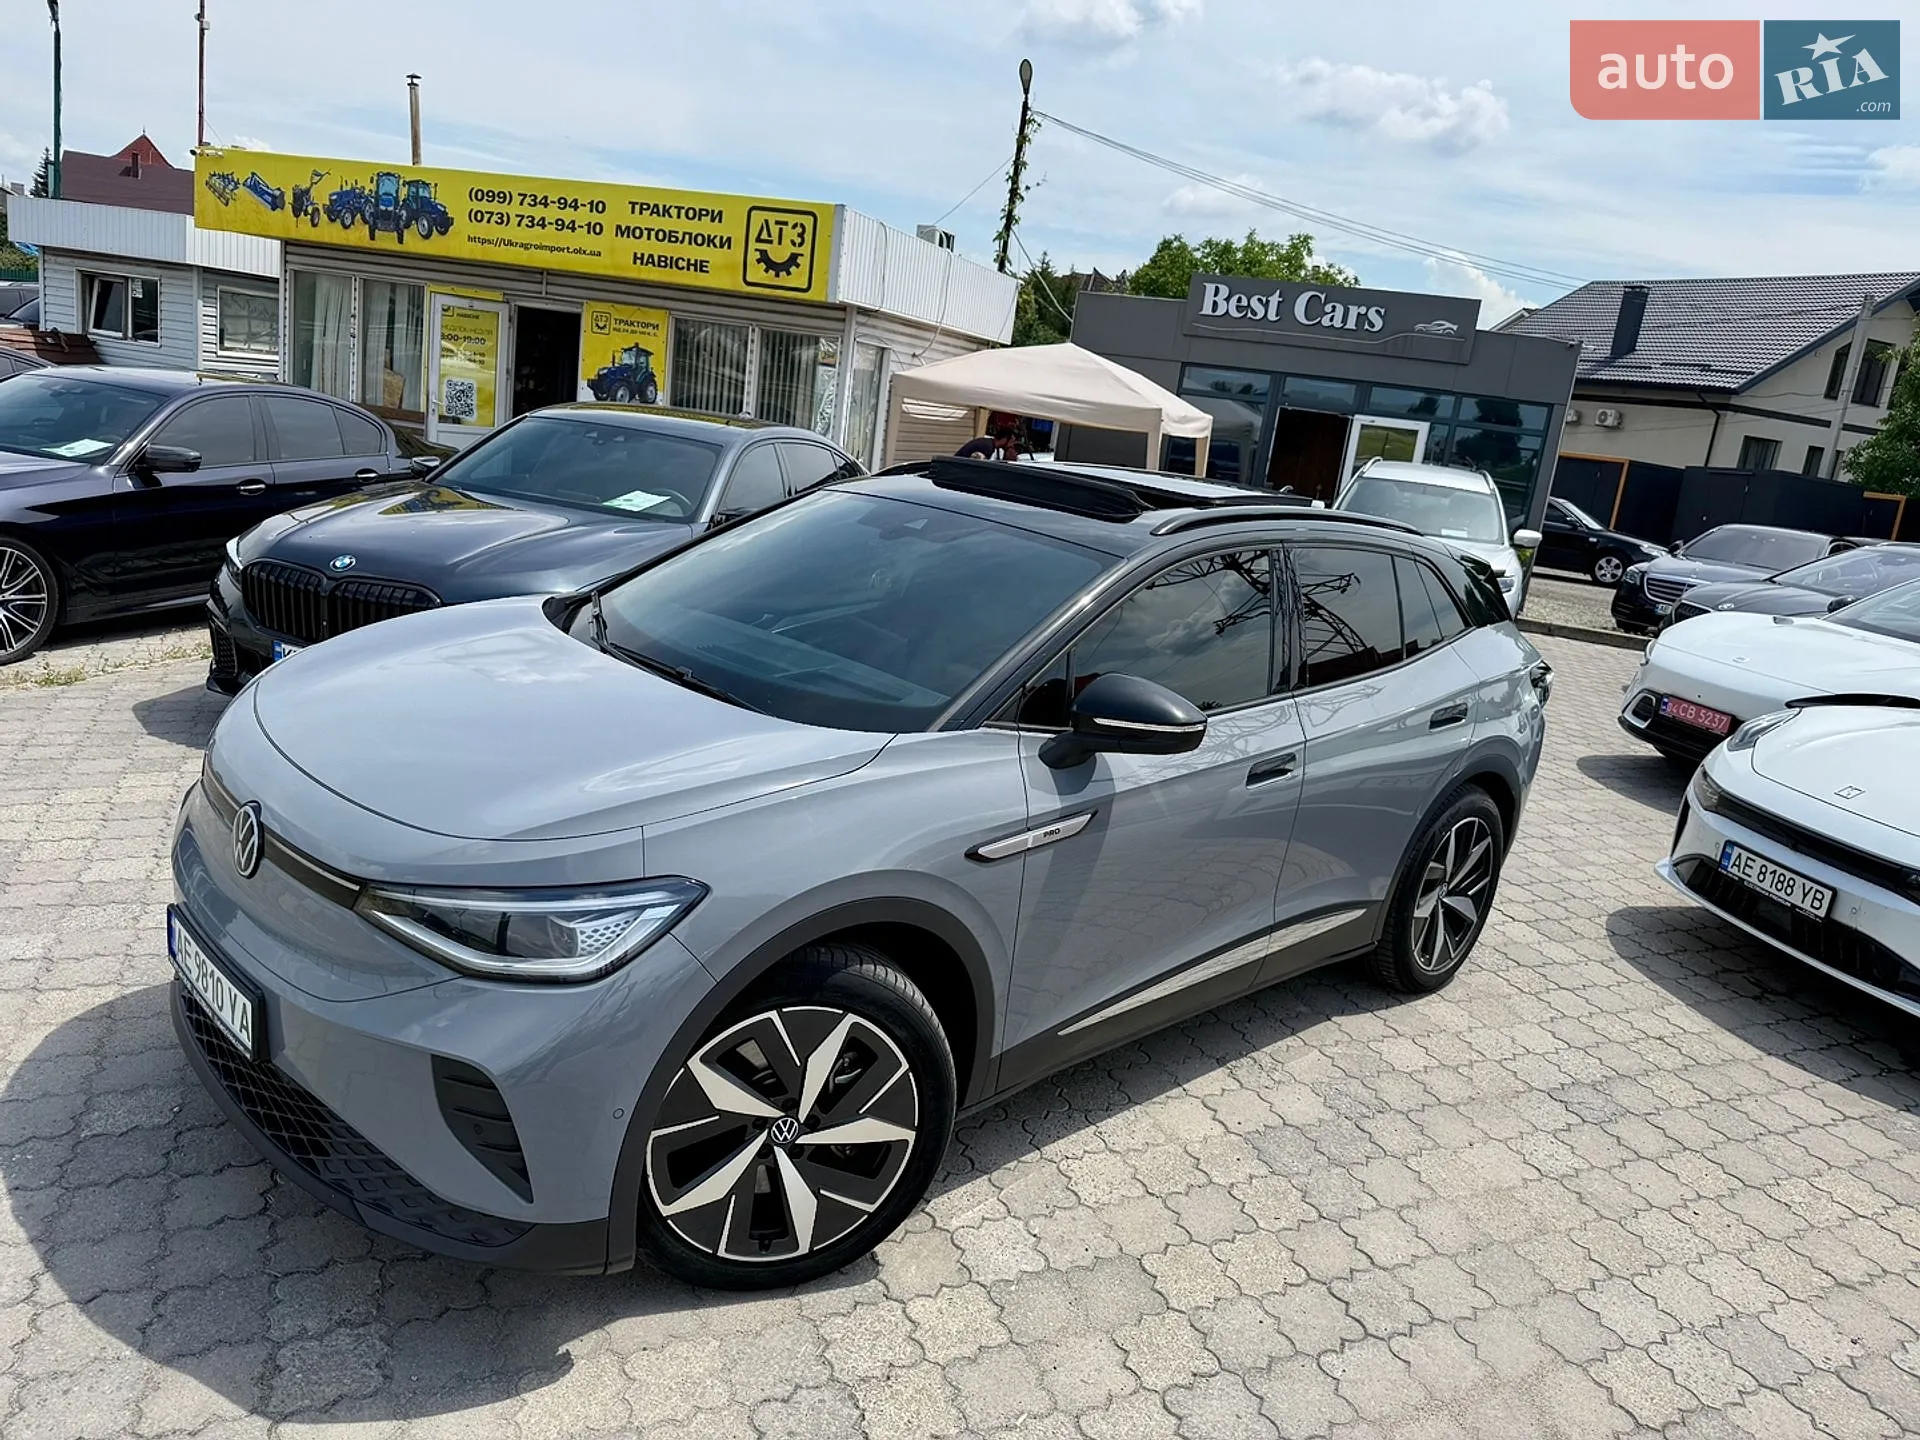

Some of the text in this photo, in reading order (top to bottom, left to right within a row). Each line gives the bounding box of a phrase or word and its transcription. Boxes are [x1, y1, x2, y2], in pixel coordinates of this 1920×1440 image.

[468, 186, 607, 214] (099) 734-94-10
[628, 201, 723, 224] ТРАКТОРИ
[467, 208, 604, 236] (073) 734-94-10
[755, 219, 807, 248] ДТЗ
[615, 224, 732, 250] МОТОБЛОКИ
[632, 252, 710, 274] НАВІСНЕ
[1199, 282, 1386, 333] Best Cars
[1698, 710, 1728, 730] 5237
[1043, 827, 1061, 838] PRO
[1730, 853, 1756, 878] AE
[1757, 864, 1796, 897] 8188
[1801, 882, 1826, 911] YB
[177, 927, 193, 975] AE
[194, 950, 224, 1012] 9810
[228, 986, 251, 1043] YA
